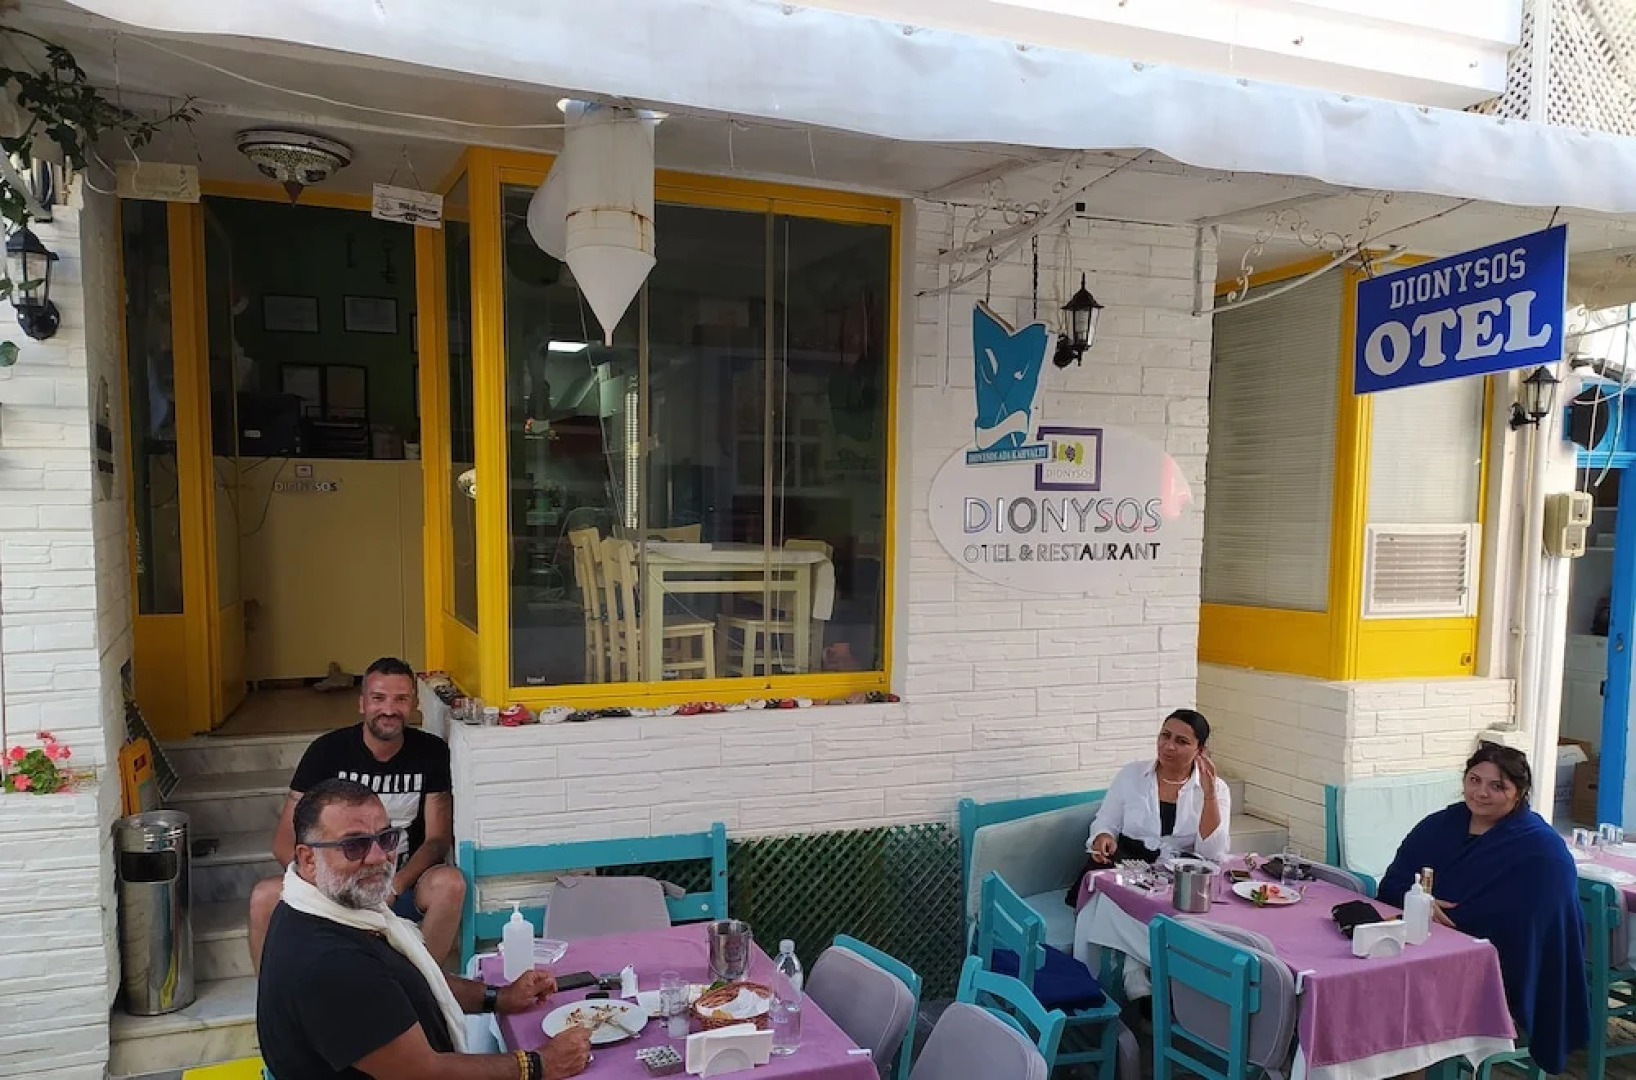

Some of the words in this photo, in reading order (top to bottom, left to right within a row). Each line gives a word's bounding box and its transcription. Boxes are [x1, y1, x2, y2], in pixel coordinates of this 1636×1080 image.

[1389, 247, 1526, 309] DIONYSOS
[1364, 290, 1552, 376] OTEL
[1046, 468, 1093, 479] DIONYSOS
[963, 497, 1163, 535] DIONYSOS
[963, 543, 1016, 564] OTEL
[1036, 542, 1161, 562] RESTAURANT
